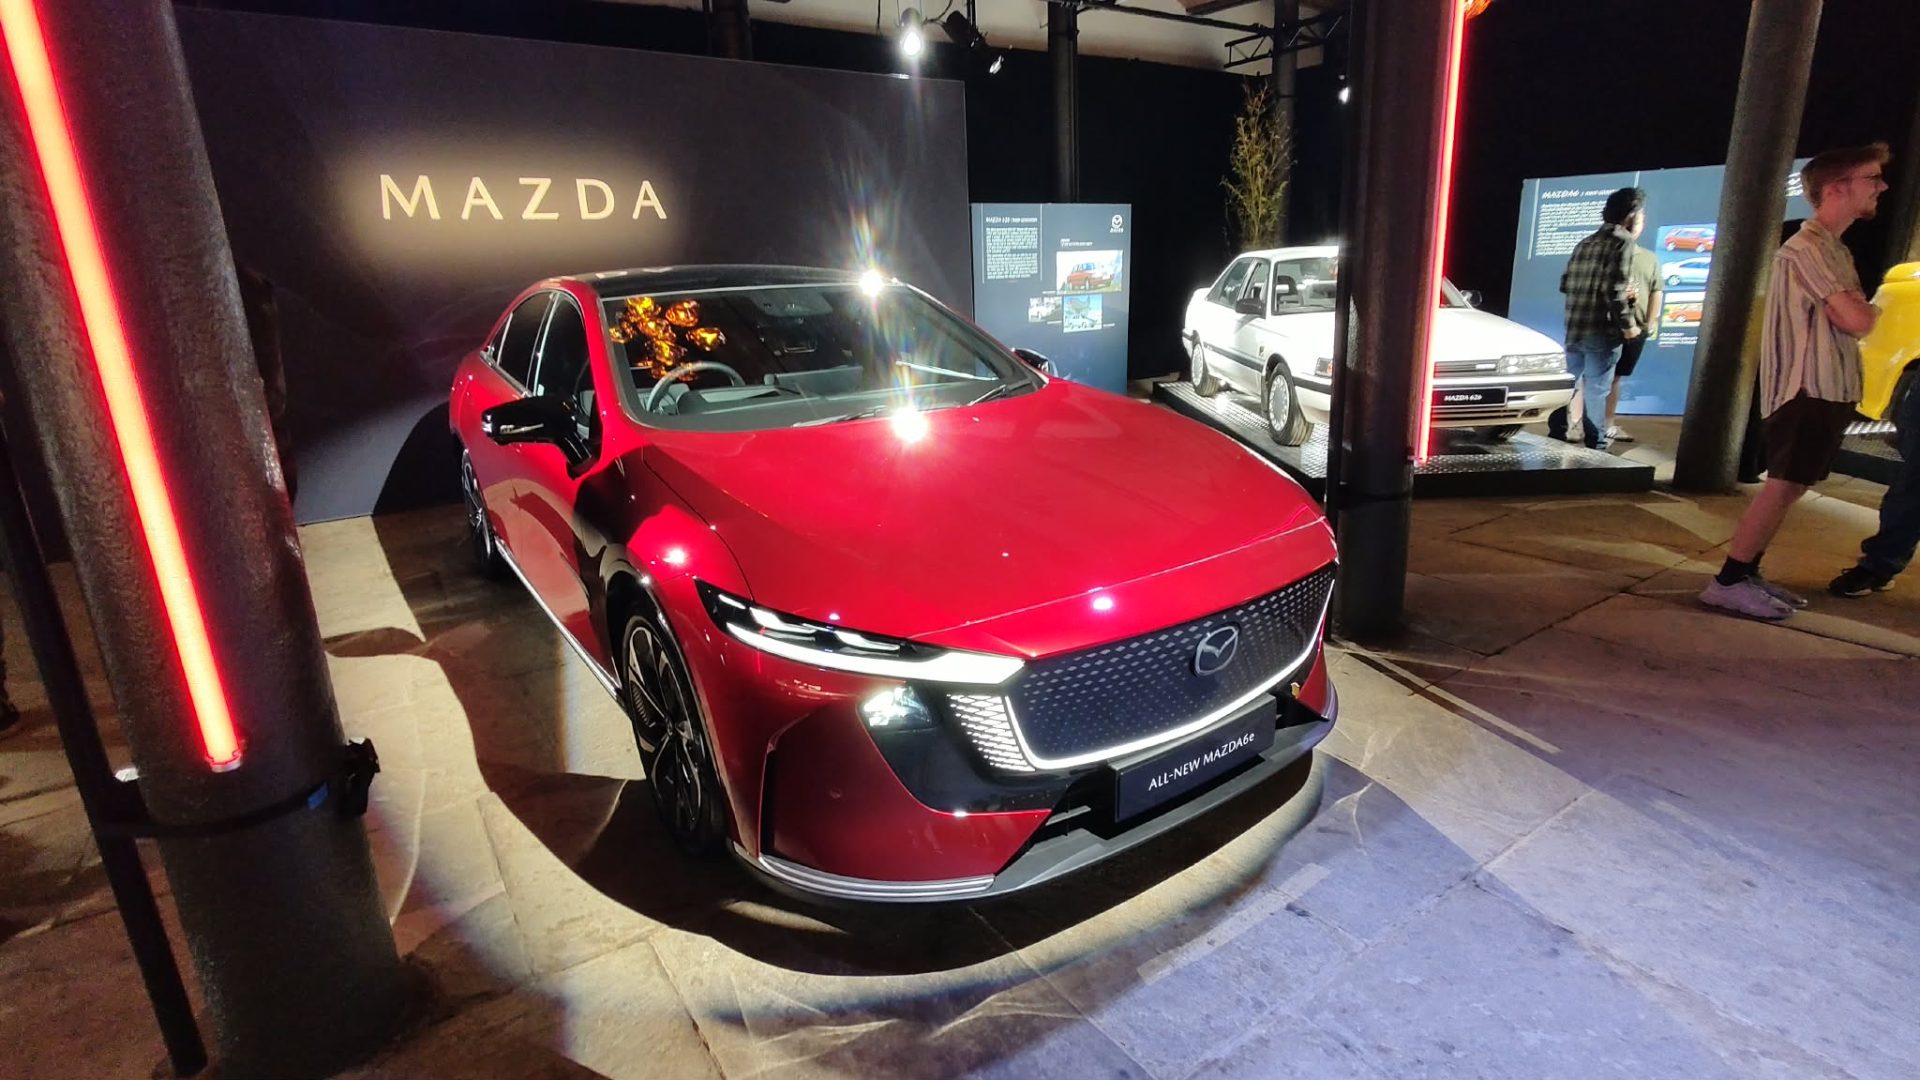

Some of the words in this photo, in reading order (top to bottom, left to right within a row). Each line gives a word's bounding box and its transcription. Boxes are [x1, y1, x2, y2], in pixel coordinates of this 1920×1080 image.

[379, 174, 668, 220] MAZDA
[1443, 394, 1469, 402] MAZDA
[1148, 756, 1201, 791] ALL-NEW
[1203, 732, 1256, 767] MAZDA6e
